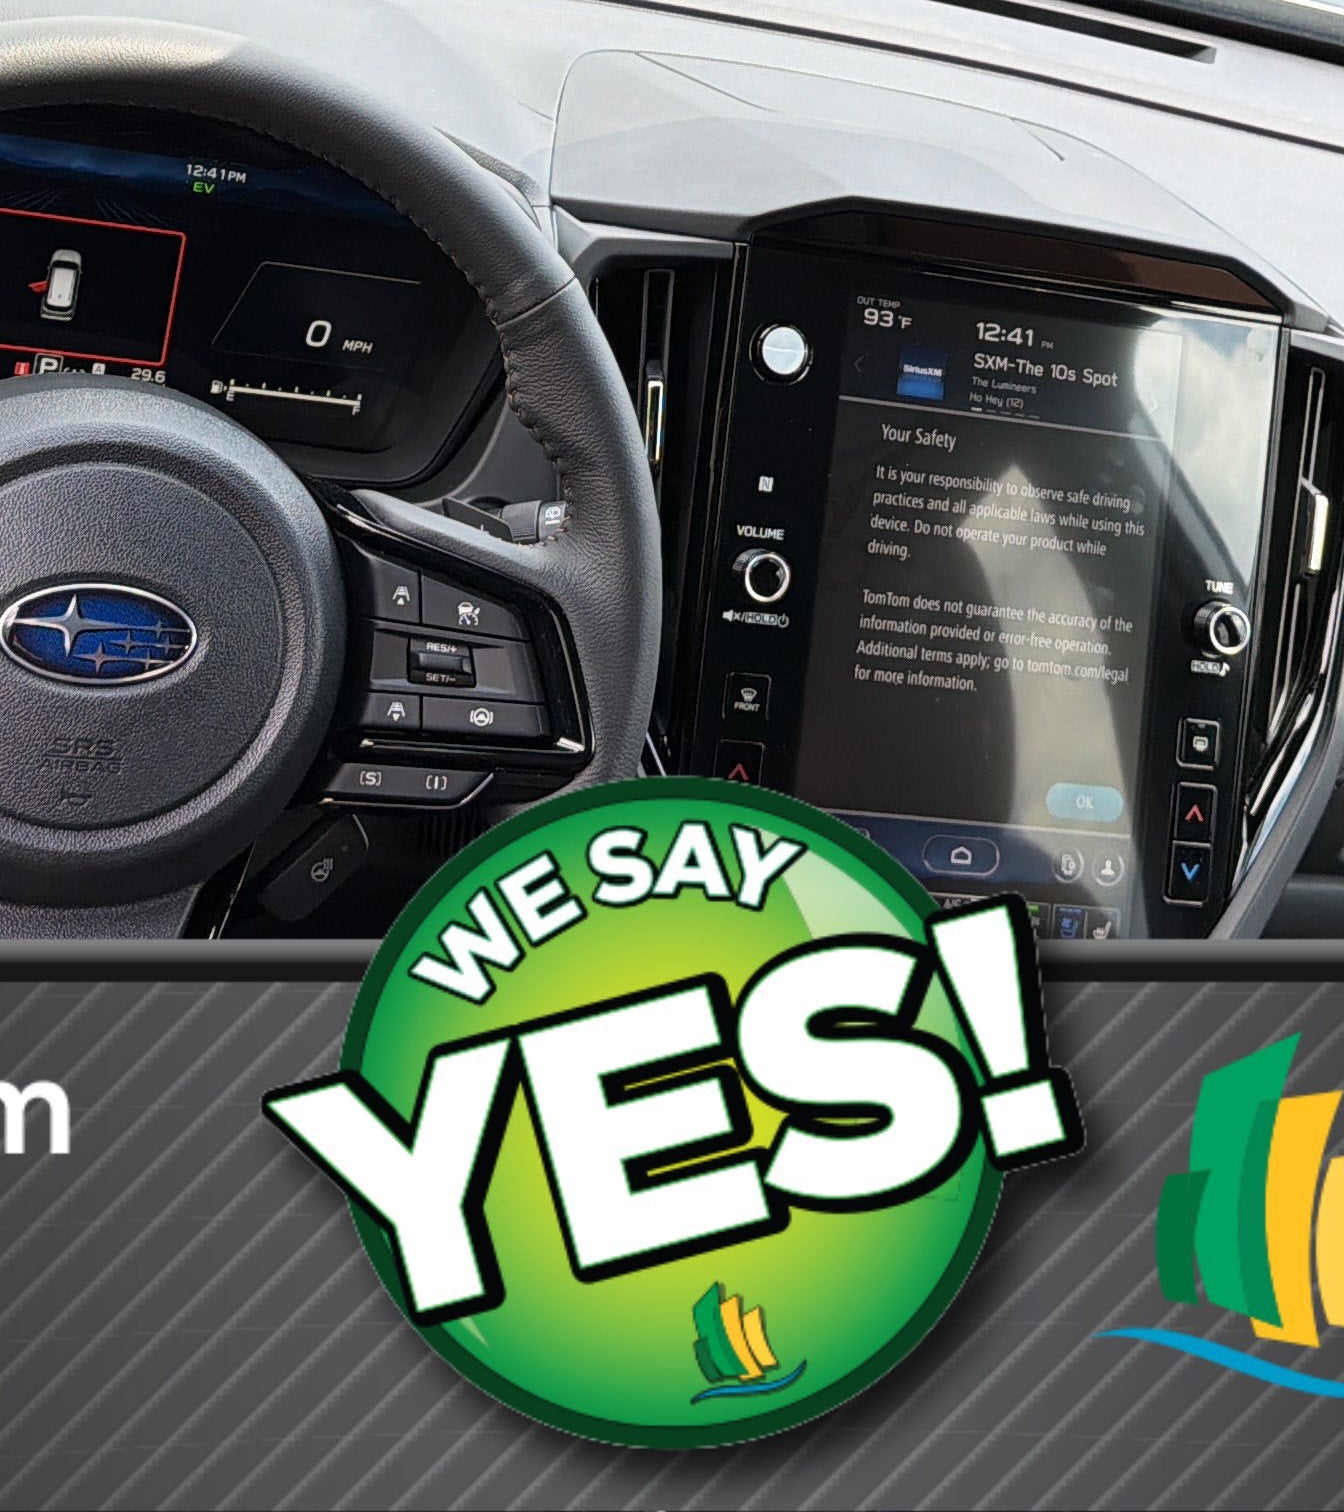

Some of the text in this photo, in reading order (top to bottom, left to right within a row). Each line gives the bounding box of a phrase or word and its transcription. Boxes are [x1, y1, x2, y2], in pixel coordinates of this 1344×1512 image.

[193, 182, 215, 193] EV
[857, 295, 901, 308] OUT TEMP
[863, 308, 894, 327] 93
[306, 320, 374, 354] 0 MPH
[976, 322, 1054, 349] 12:41 PM
[130, 367, 166, 383] 29.6
[974, 352, 1119, 387] SXM-The 10s Spot
[971, 376, 1037, 394] The Lumineers
[969, 392, 983, 403] Ho
[985, 393, 1003, 407] Hey
[881, 423, 957, 453] Your Safety
[876, 464, 1130, 513] It is your responsibility to observe safe driving
[873, 491, 1145, 537] practices and all applicable laws while using this
[736, 524, 785, 541] VOLUME
[870, 516, 1107, 557] device. Do not operate your product while
[867, 538, 911, 562] driving.
[1205, 579, 1234, 595] TUNE
[862, 588, 1133, 633] TomTom does not guarantee the accuracy of the
[859, 614, 1112, 656] information provided or error-free operation.
[856, 639, 918, 660] Additional
[921, 648, 953, 664] terms
[993, 656, 1009, 672] go
[1011, 657, 1024, 671] to
[1027, 659, 1129, 684] tomtom.com/legal
[854, 663, 978, 692] for more information.
[734, 701, 761, 712] FRONT
[50, 736, 117, 758] SRS
[40, 758, 125, 776] AIRBAG
[1076, 792, 1095, 810] OK
